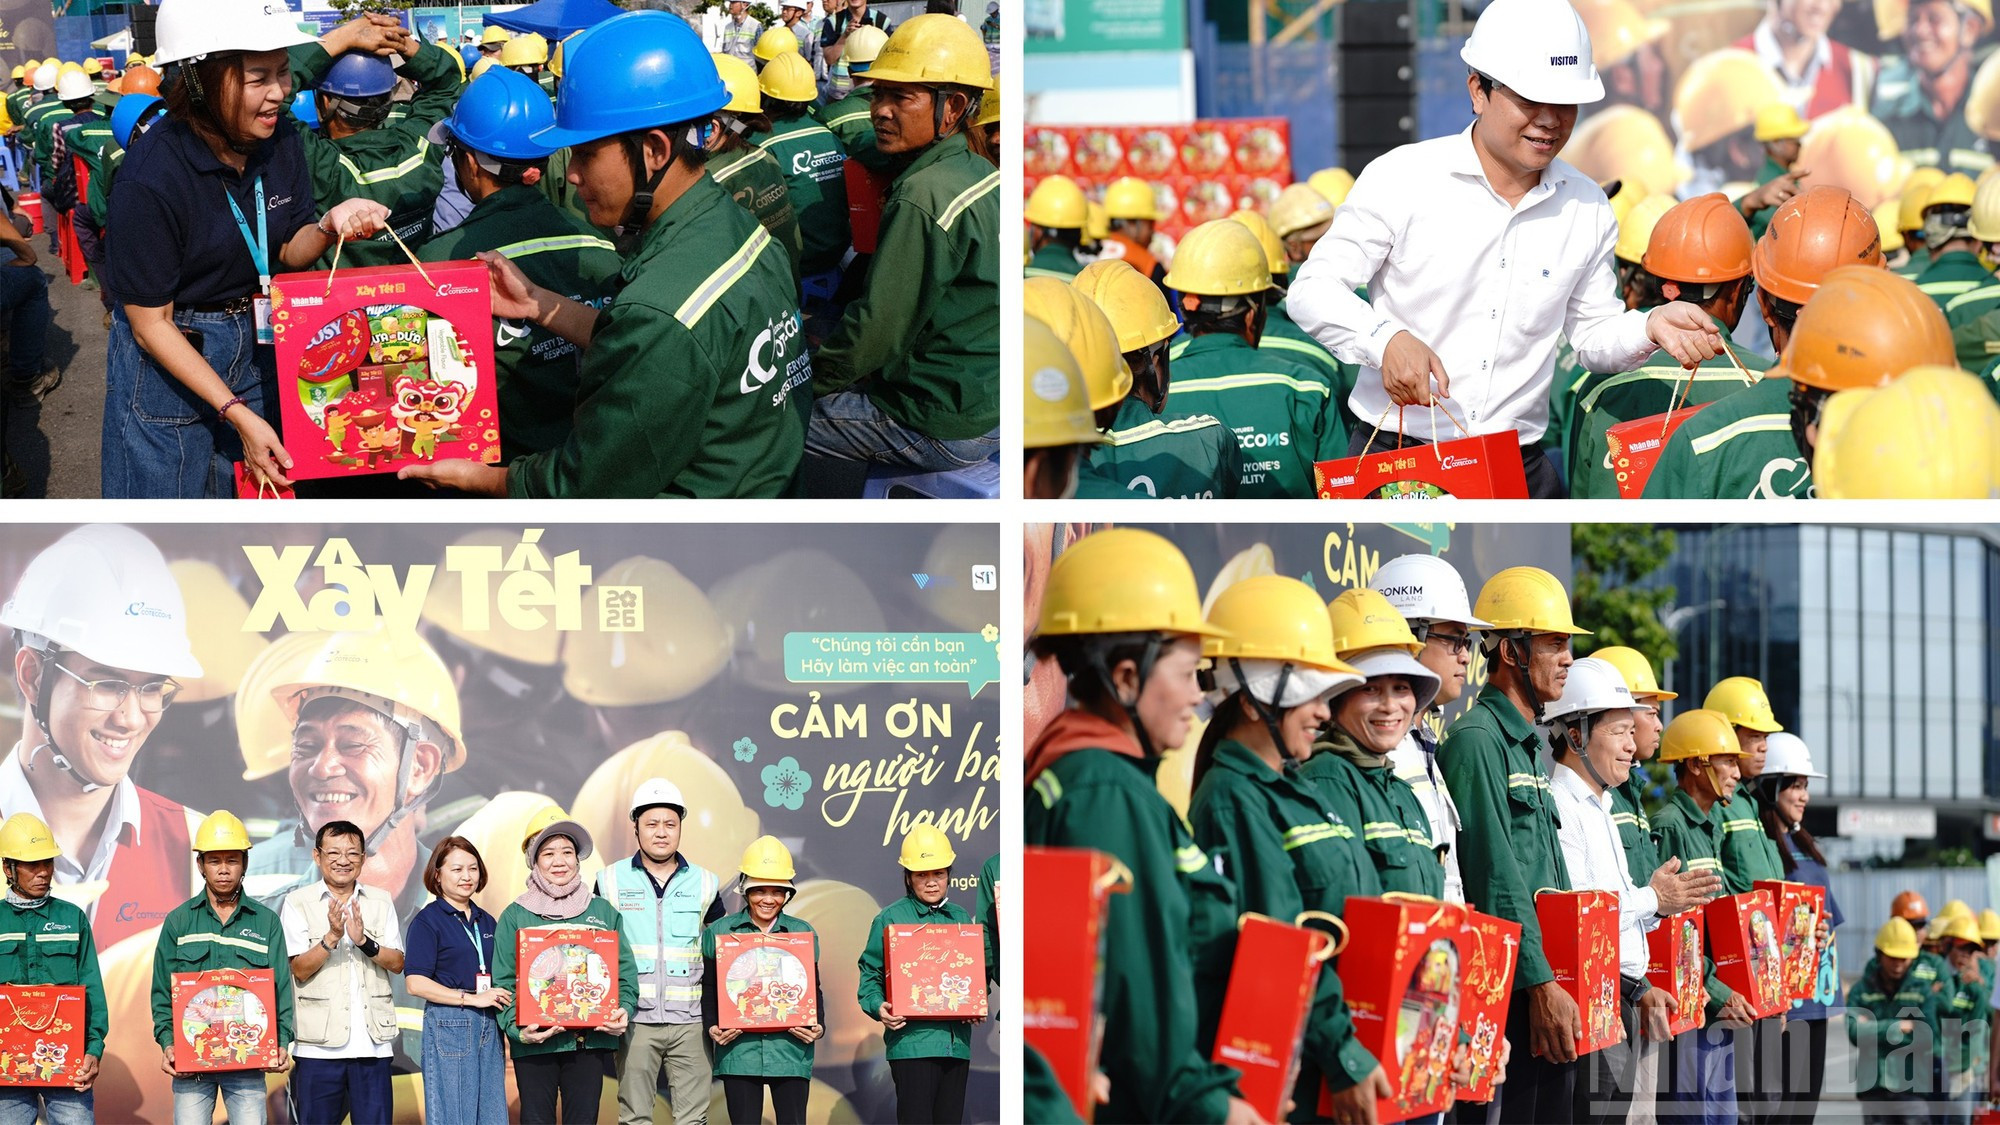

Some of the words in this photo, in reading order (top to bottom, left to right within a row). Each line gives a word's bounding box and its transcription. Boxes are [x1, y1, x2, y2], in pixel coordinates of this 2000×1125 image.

[1550, 56, 1578, 66] VISITOR
[755, 185, 788, 208] COTECCO
[355, 284, 377, 297] Xây
[378, 282, 395, 294] Tết
[532, 339, 557, 356] SAFETY
[543, 343, 577, 361] RESPONS
[1237, 432, 1290, 449] CCONS
[1243, 460, 1281, 473] YONE'S
[1377, 462, 1393, 474] Xây
[1323, 522, 1380, 589] CẢM
[241, 537, 437, 640] Xây
[446, 528, 592, 632] Tết
[812, 637, 871, 656] “Chúng
[876, 637, 897, 652] tôi
[901, 635, 930, 652] cần
[935, 638, 965, 656] bạn
[801, 658, 833, 676] Hãy
[838, 658, 868, 673] làm
[873, 660, 905, 676] việc
[910, 661, 929, 673] an
[934, 658, 977, 673] toàn”
[770, 690, 868, 739] CẢM
[885, 697, 952, 738] ƠN
[821, 743, 945, 828] người
[951, 873, 981, 890] ngà
